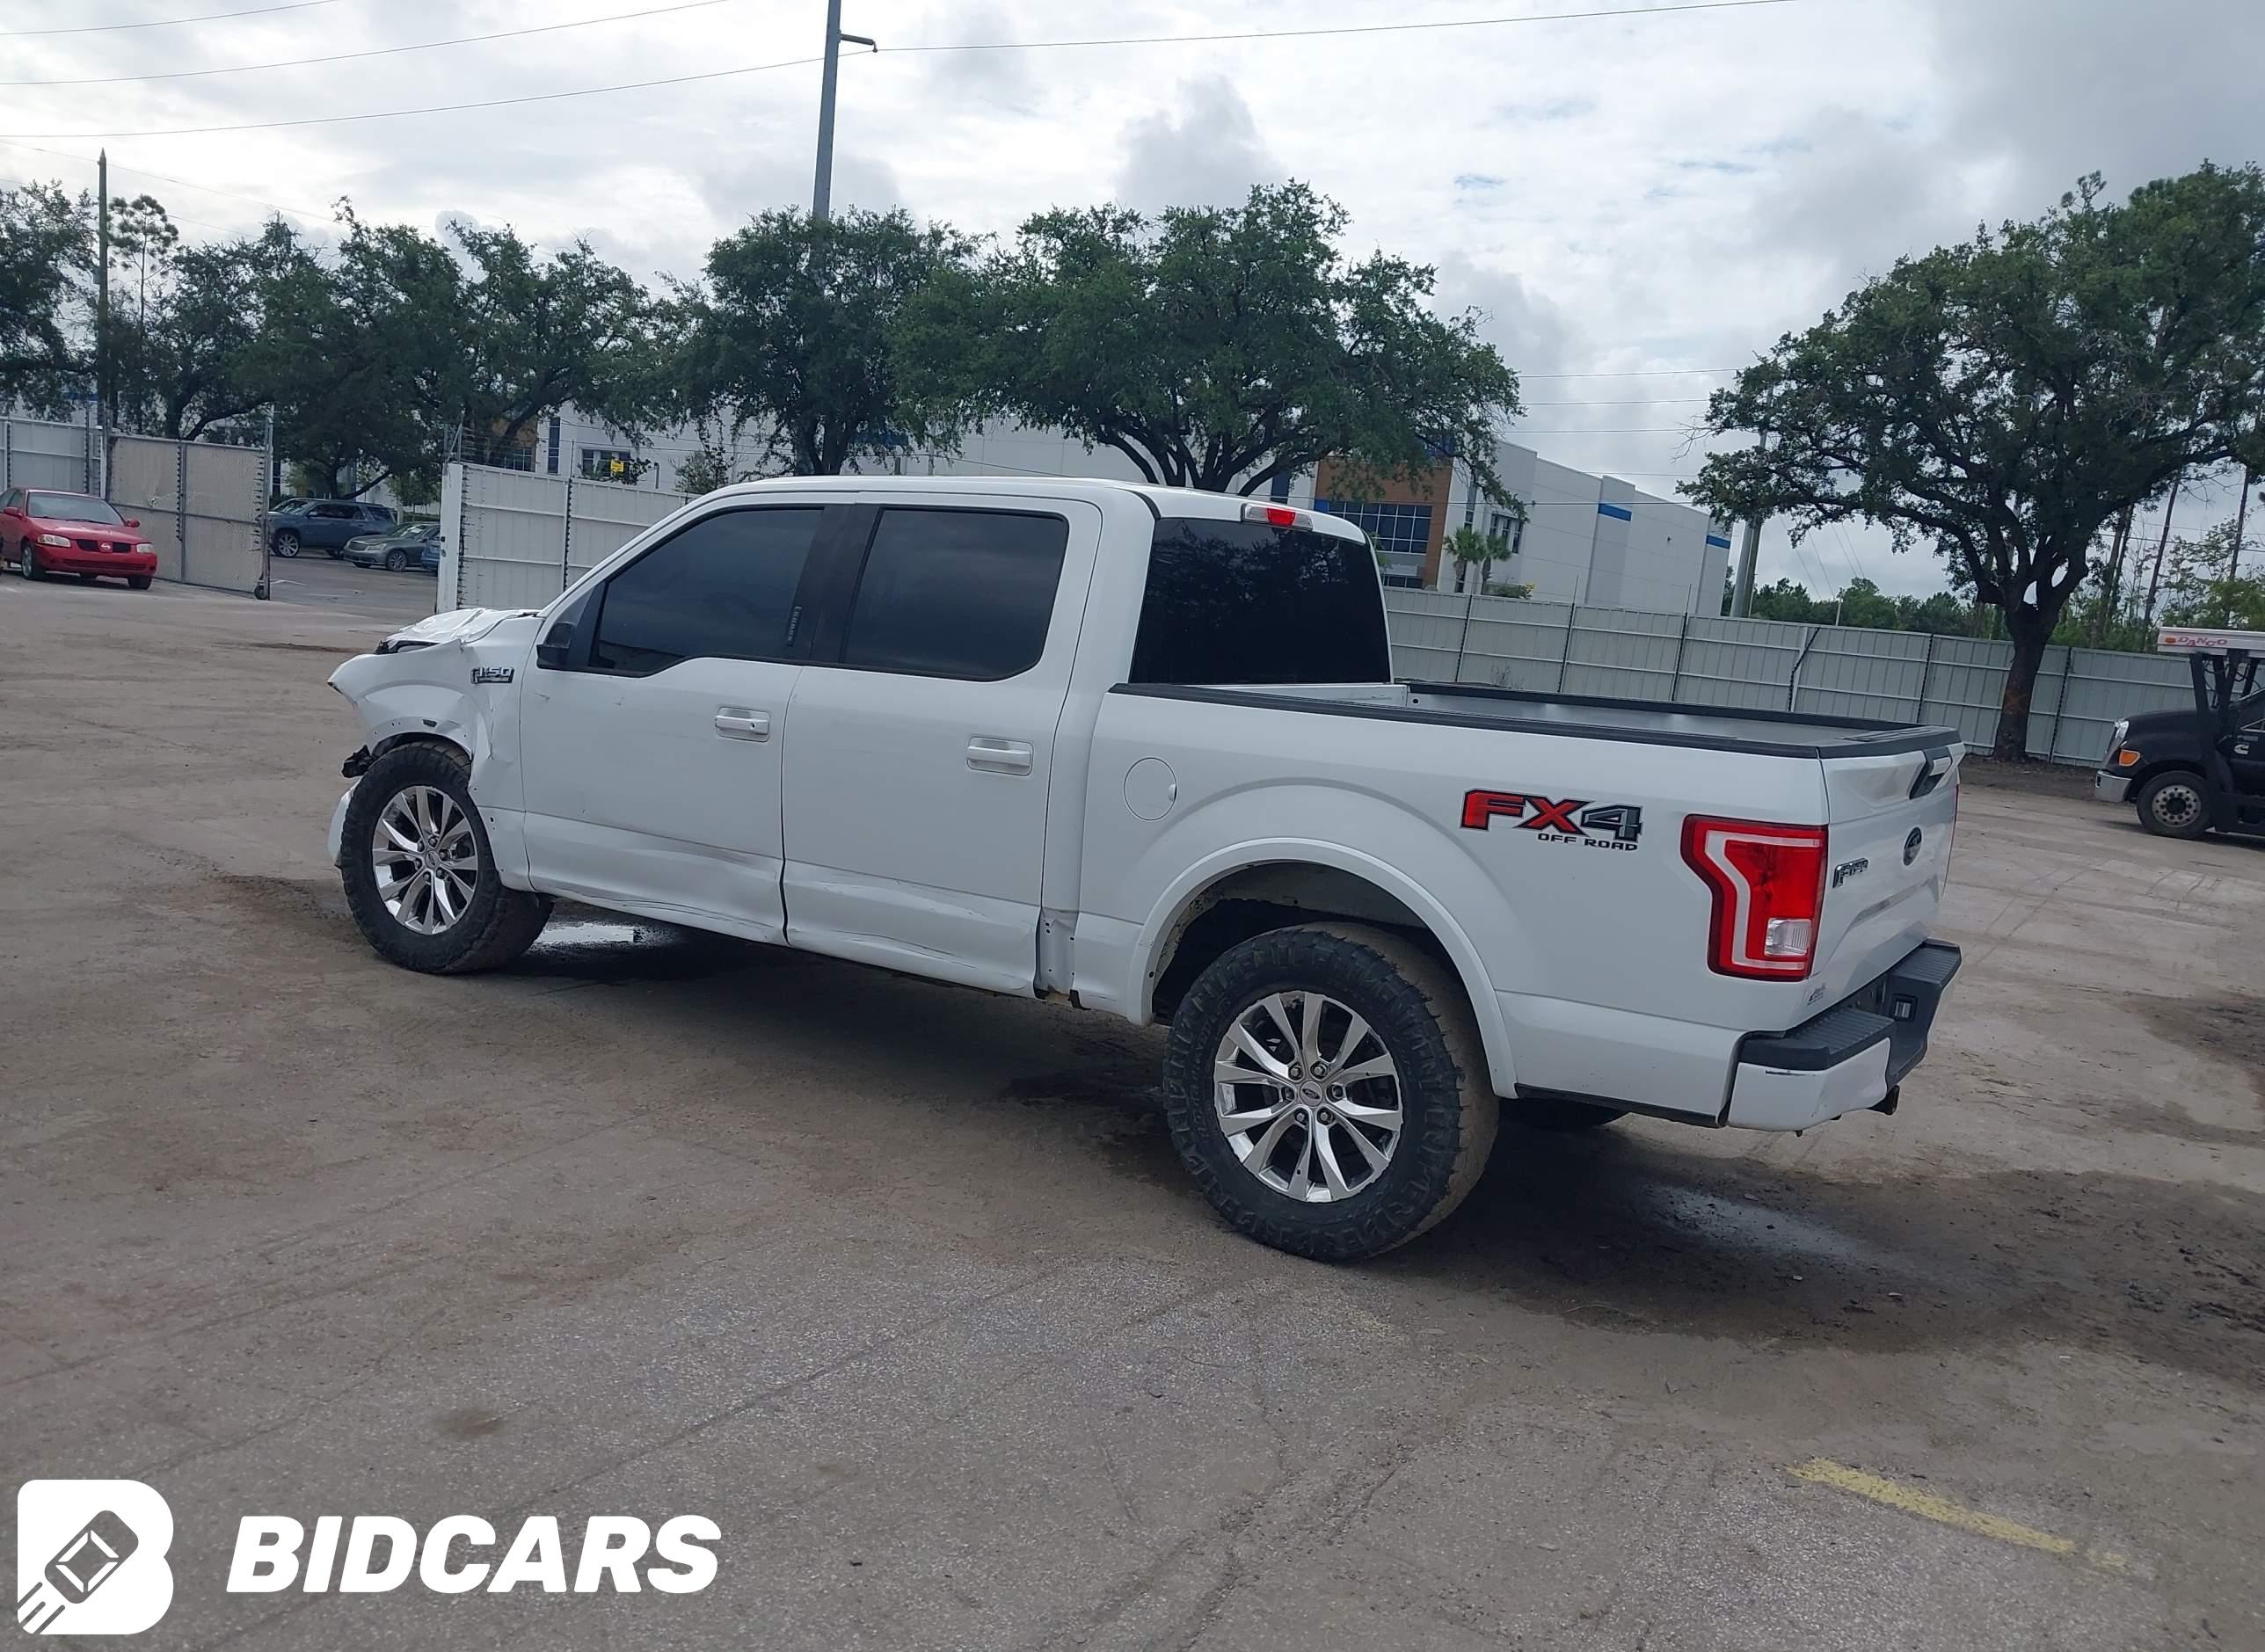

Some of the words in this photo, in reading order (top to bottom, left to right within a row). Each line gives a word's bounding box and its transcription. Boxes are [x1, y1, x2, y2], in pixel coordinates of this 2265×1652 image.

[1460, 789, 1643, 842] FX4
[1537, 833, 1577, 844] OFF
[1584, 838, 1639, 852] ROAD
